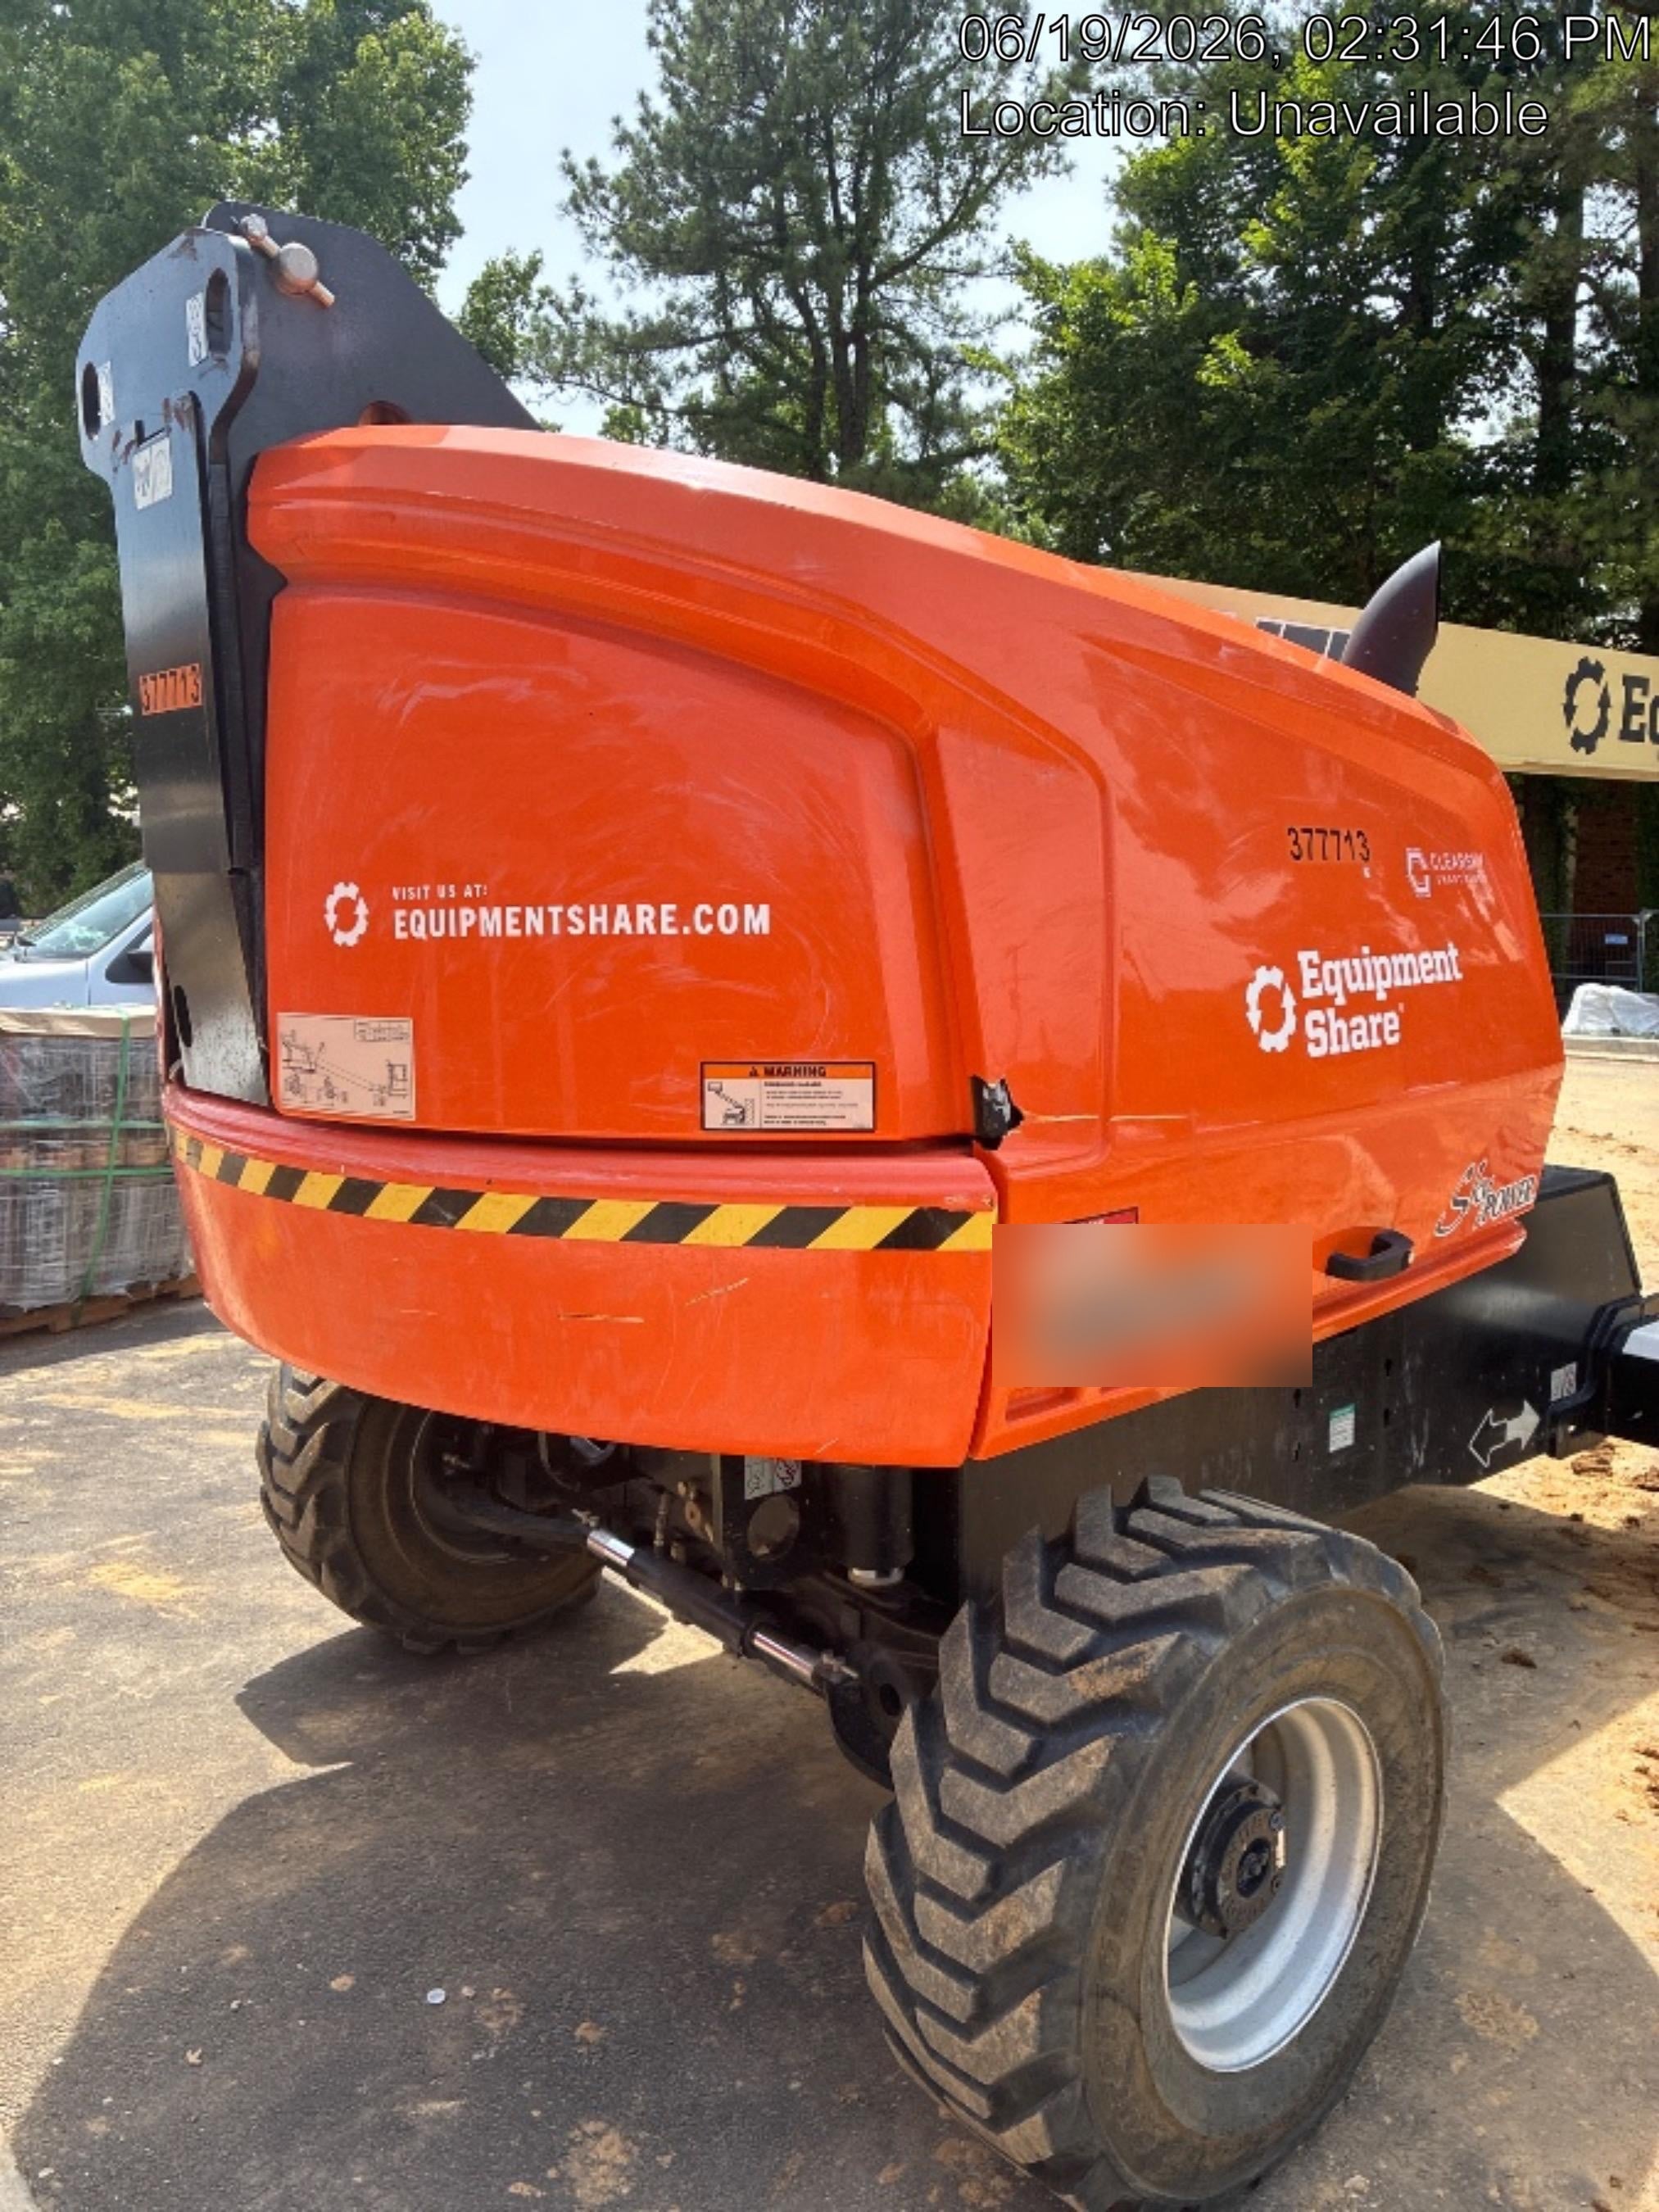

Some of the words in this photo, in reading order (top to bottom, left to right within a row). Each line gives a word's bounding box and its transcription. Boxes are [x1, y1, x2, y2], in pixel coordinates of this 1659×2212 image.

[142, 664, 201, 712] 377713
[1287, 827, 1371, 862] 377713
[392, 884, 431, 900] VISIT
[437, 884, 456, 899] US
[464, 883, 488, 899] AT:
[393, 904, 772, 941] EQUIPMENTSHARE.COM
[1297, 941, 1464, 1005] Equipment
[1304, 1007, 1401, 1058] Share
[763, 1066, 827, 1078] WARNING
